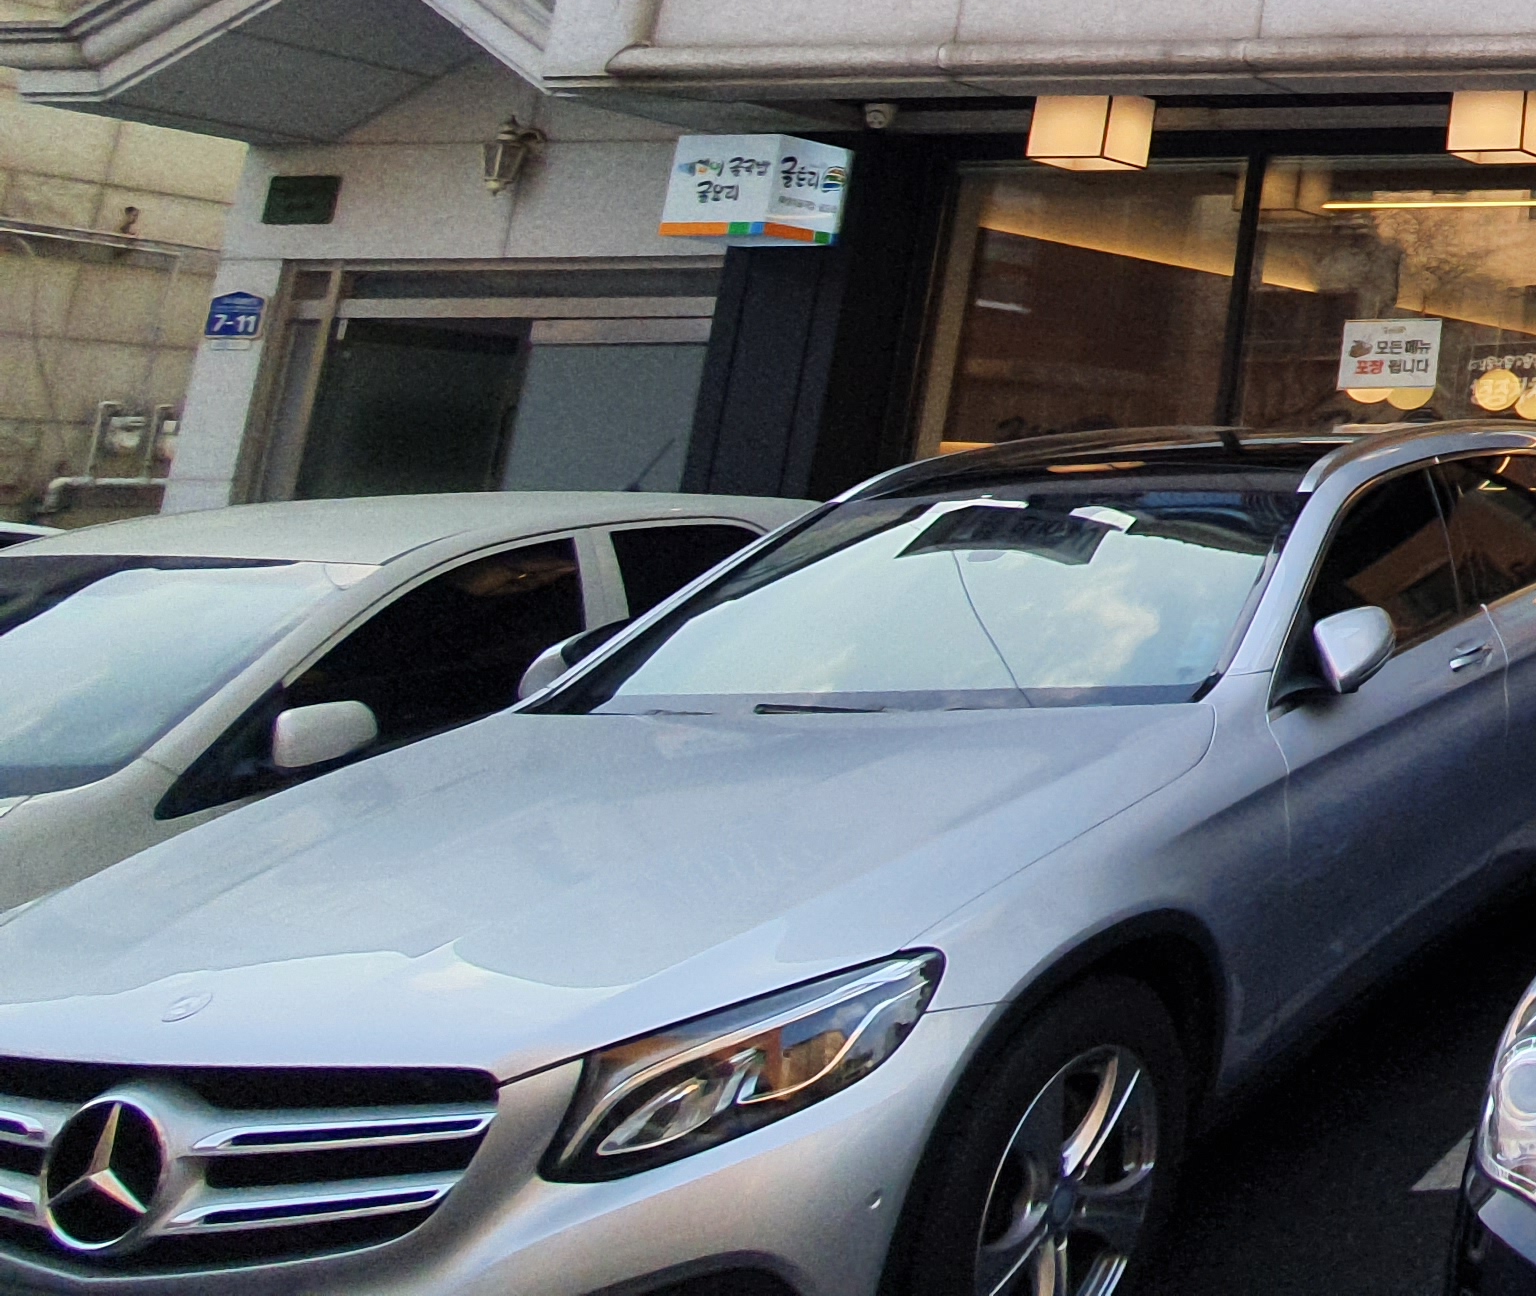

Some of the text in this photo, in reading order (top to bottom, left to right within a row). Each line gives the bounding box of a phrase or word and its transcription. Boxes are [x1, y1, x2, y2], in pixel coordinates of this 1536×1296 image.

[780, 155, 820, 190] 굴토리
[211, 313, 257, 333] 7-11
[1374, 339, 1432, 355] 모든 메뉴
[1355, 359, 1385, 375] 포장
